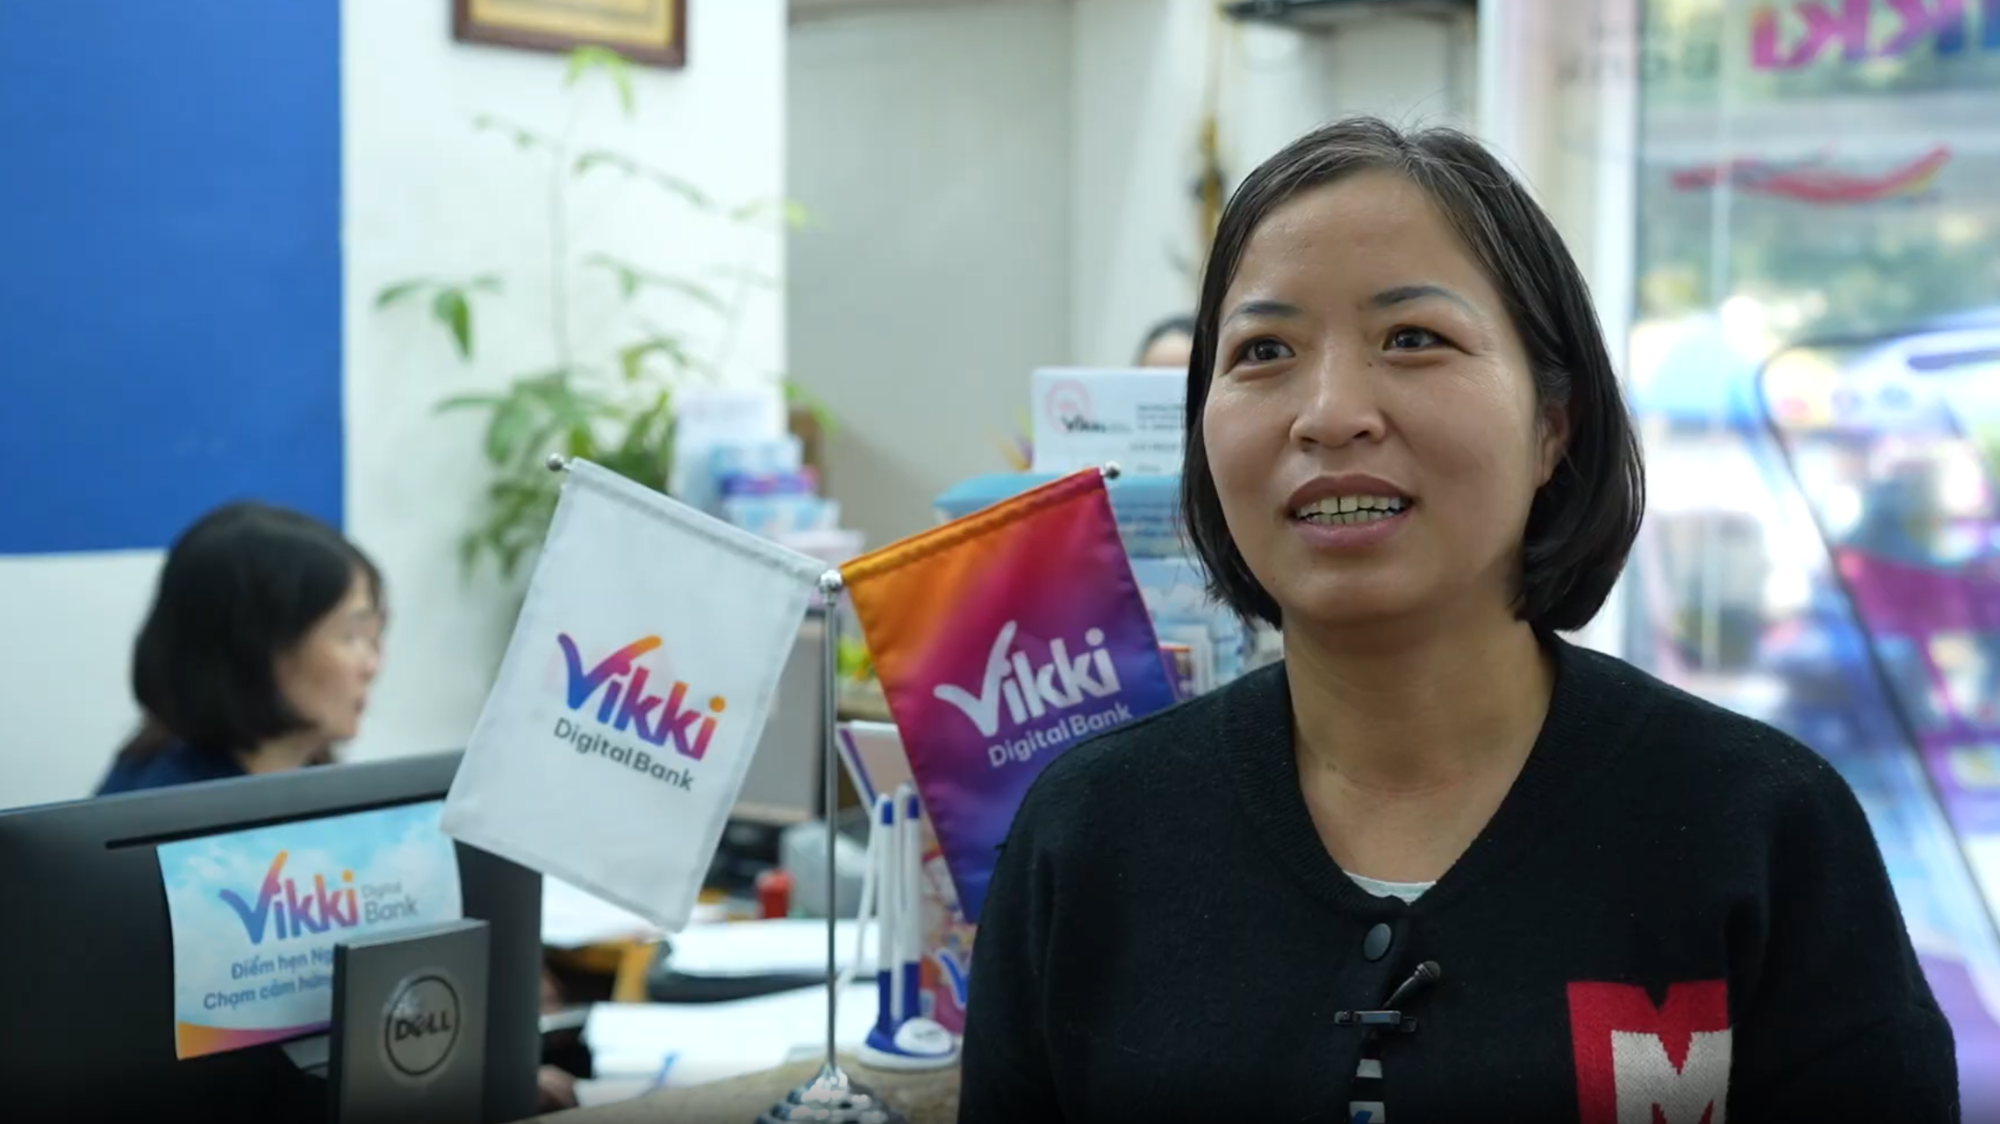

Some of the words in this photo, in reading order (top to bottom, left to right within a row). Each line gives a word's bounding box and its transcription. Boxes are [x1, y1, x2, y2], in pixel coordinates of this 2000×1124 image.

[556, 632, 727, 762] Vikki
[933, 619, 1122, 738] Vikki
[218, 850, 360, 945] Vikki
[364, 894, 419, 926] Bank
[395, 1010, 452, 1042] DELL
